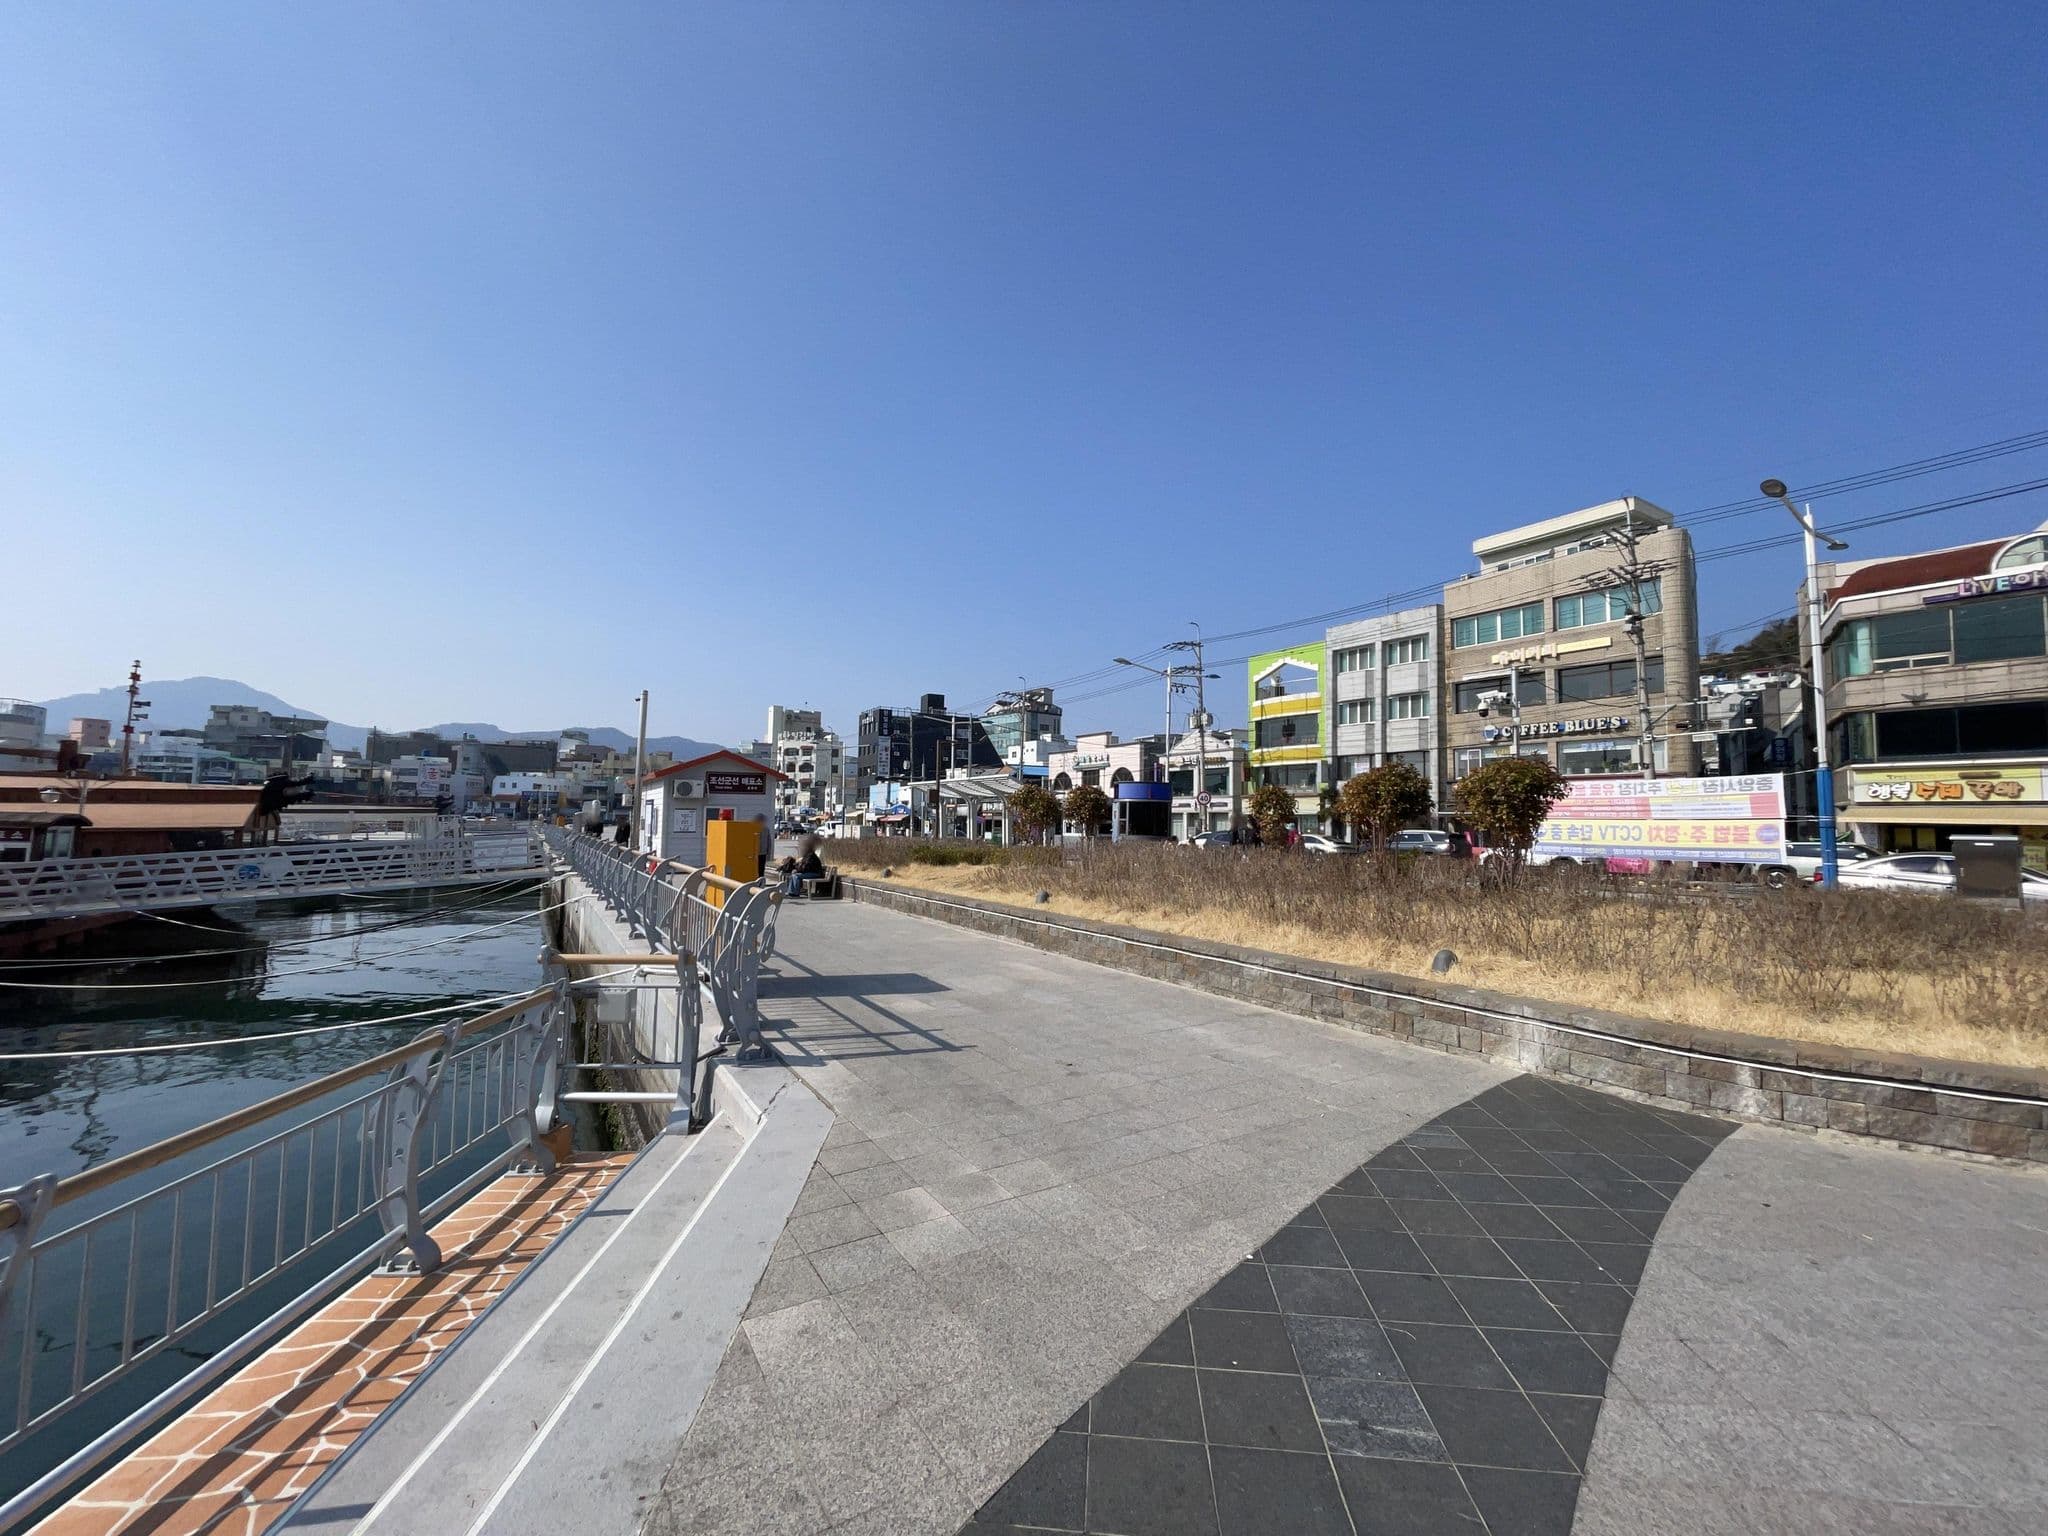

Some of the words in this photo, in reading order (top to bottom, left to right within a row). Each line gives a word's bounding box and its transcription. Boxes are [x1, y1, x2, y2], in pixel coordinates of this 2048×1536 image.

[1957, 578, 2010, 597] LIVE
[1502, 722, 1559, 737] CFFEE
[1564, 716, 1621, 734] BLUE'S
[741, 776, 763, 787] 매표소
[1868, 781, 1911, 800] 행복
[1916, 781, 1964, 800] 수제
